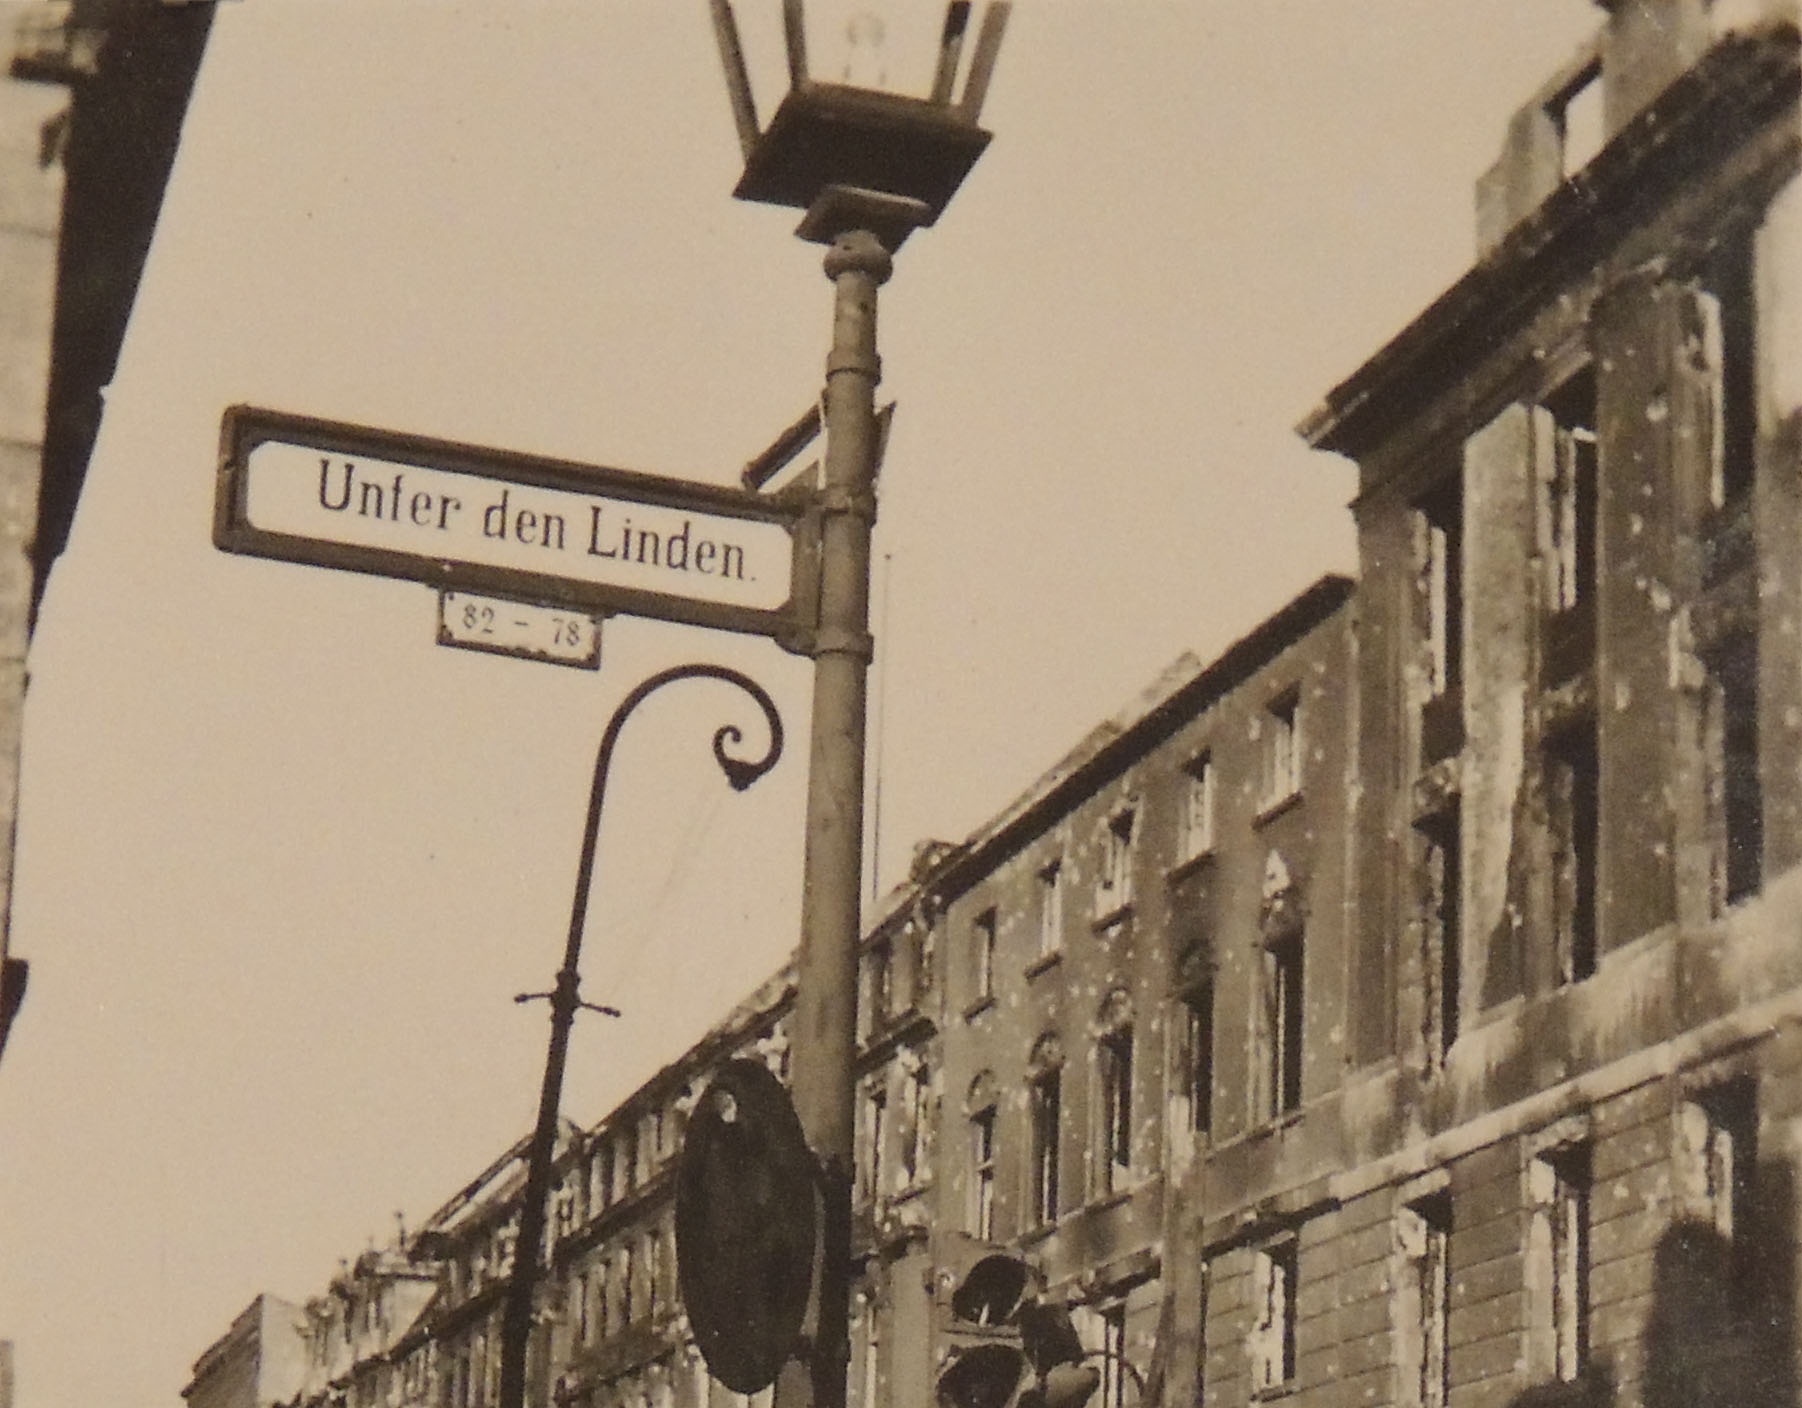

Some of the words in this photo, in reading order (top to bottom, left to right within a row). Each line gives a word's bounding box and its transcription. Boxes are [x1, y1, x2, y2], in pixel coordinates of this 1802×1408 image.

[318, 457, 462, 530] Unter
[483, 488, 565, 550] den
[462, 603, 496, 635] 82
[551, 616, 581, 647] 78
